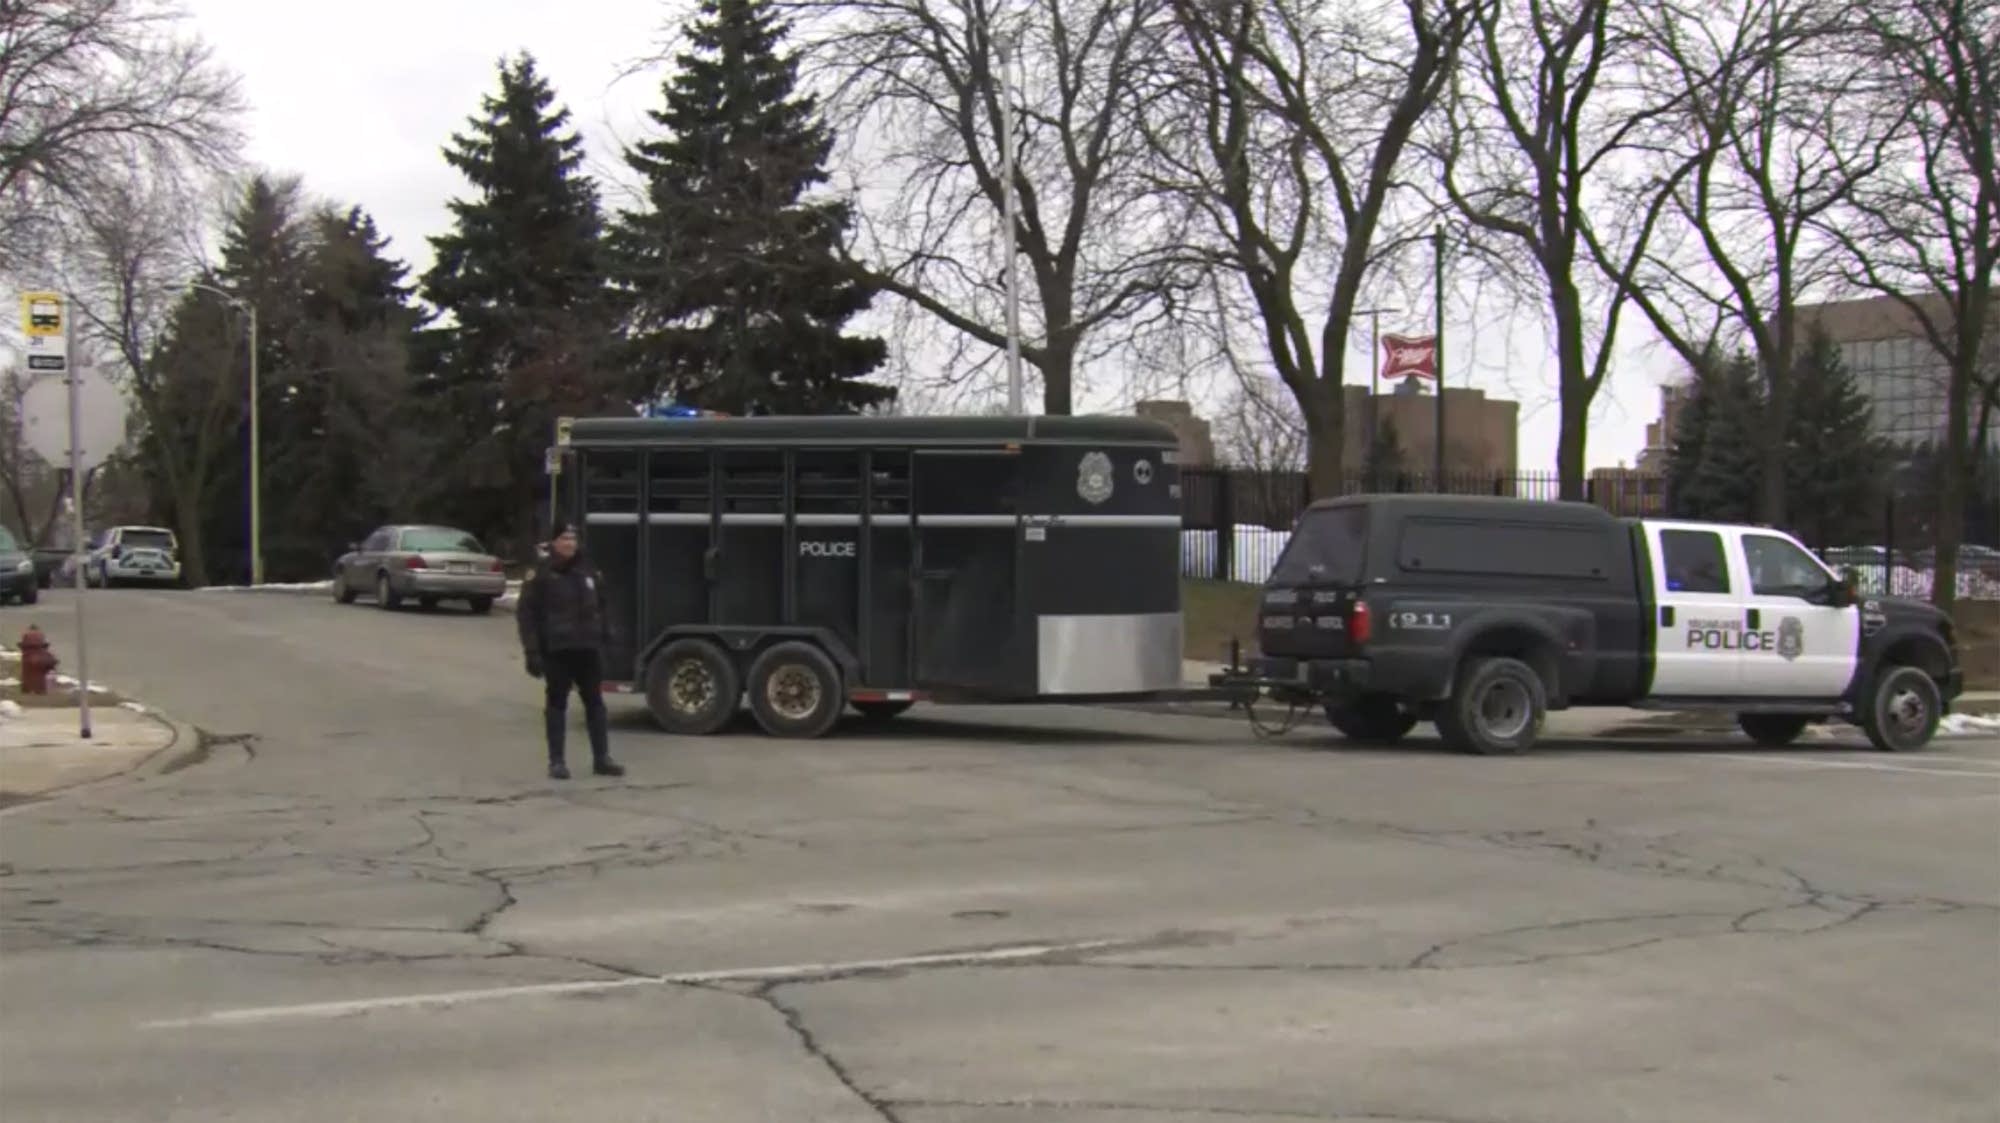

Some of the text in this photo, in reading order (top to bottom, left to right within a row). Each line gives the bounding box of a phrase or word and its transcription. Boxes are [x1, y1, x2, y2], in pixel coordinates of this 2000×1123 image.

[800, 541, 856, 557] POLICE
[1401, 612, 1450, 626] 911
[1687, 629, 1774, 650] POLICE
